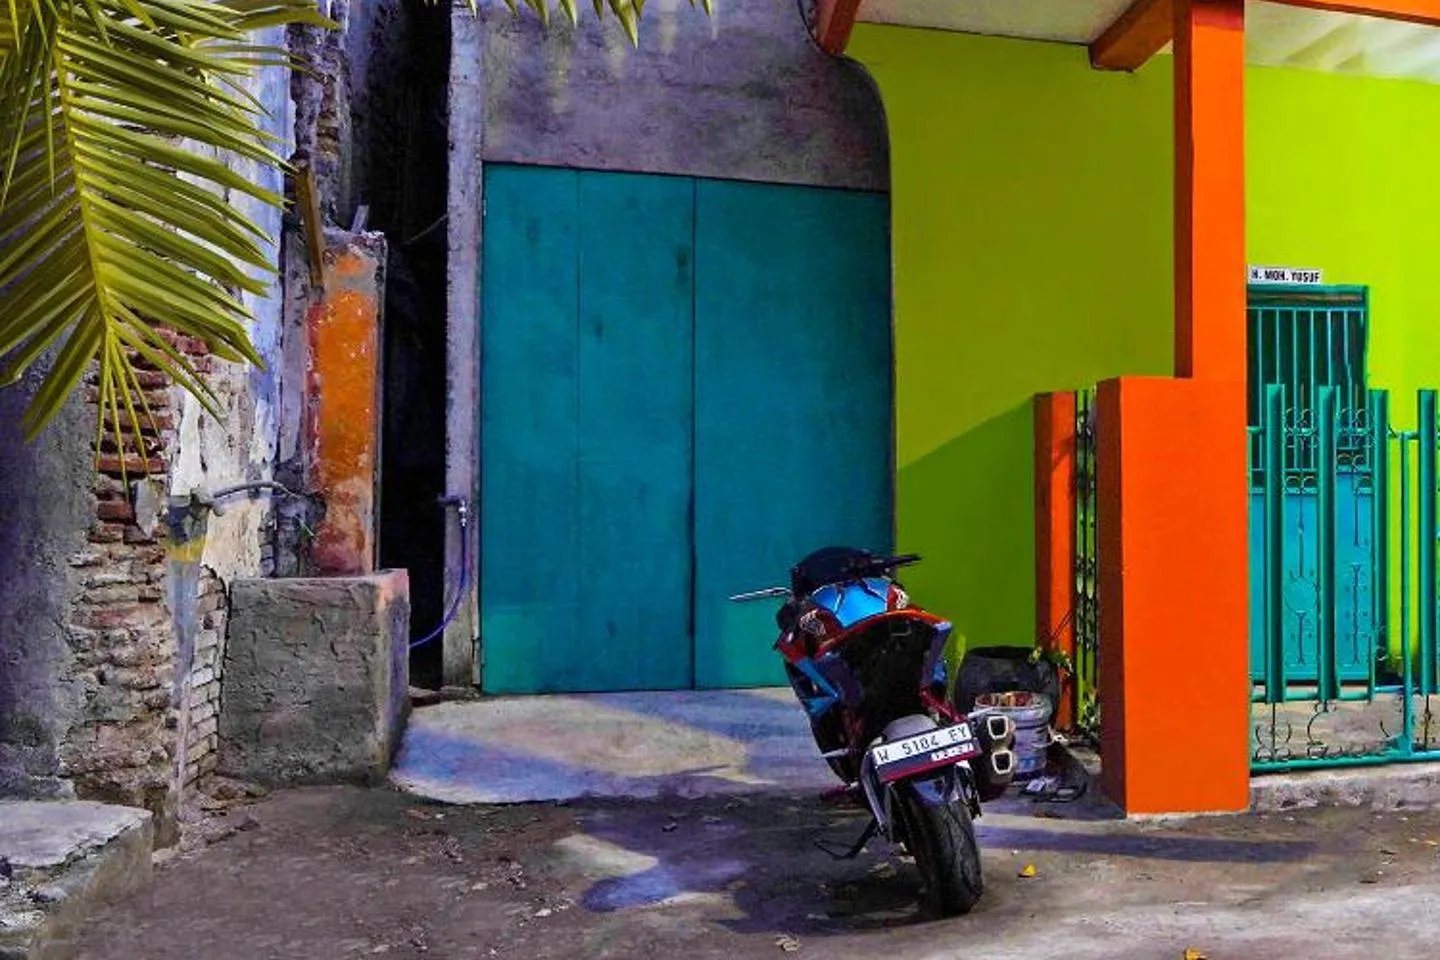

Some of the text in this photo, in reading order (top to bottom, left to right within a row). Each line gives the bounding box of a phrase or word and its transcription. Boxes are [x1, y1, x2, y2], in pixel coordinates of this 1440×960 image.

[1265, 270, 1289, 281] MOH.
[1291, 272, 1320, 282] YUSUF
[877, 749, 889, 761] W
